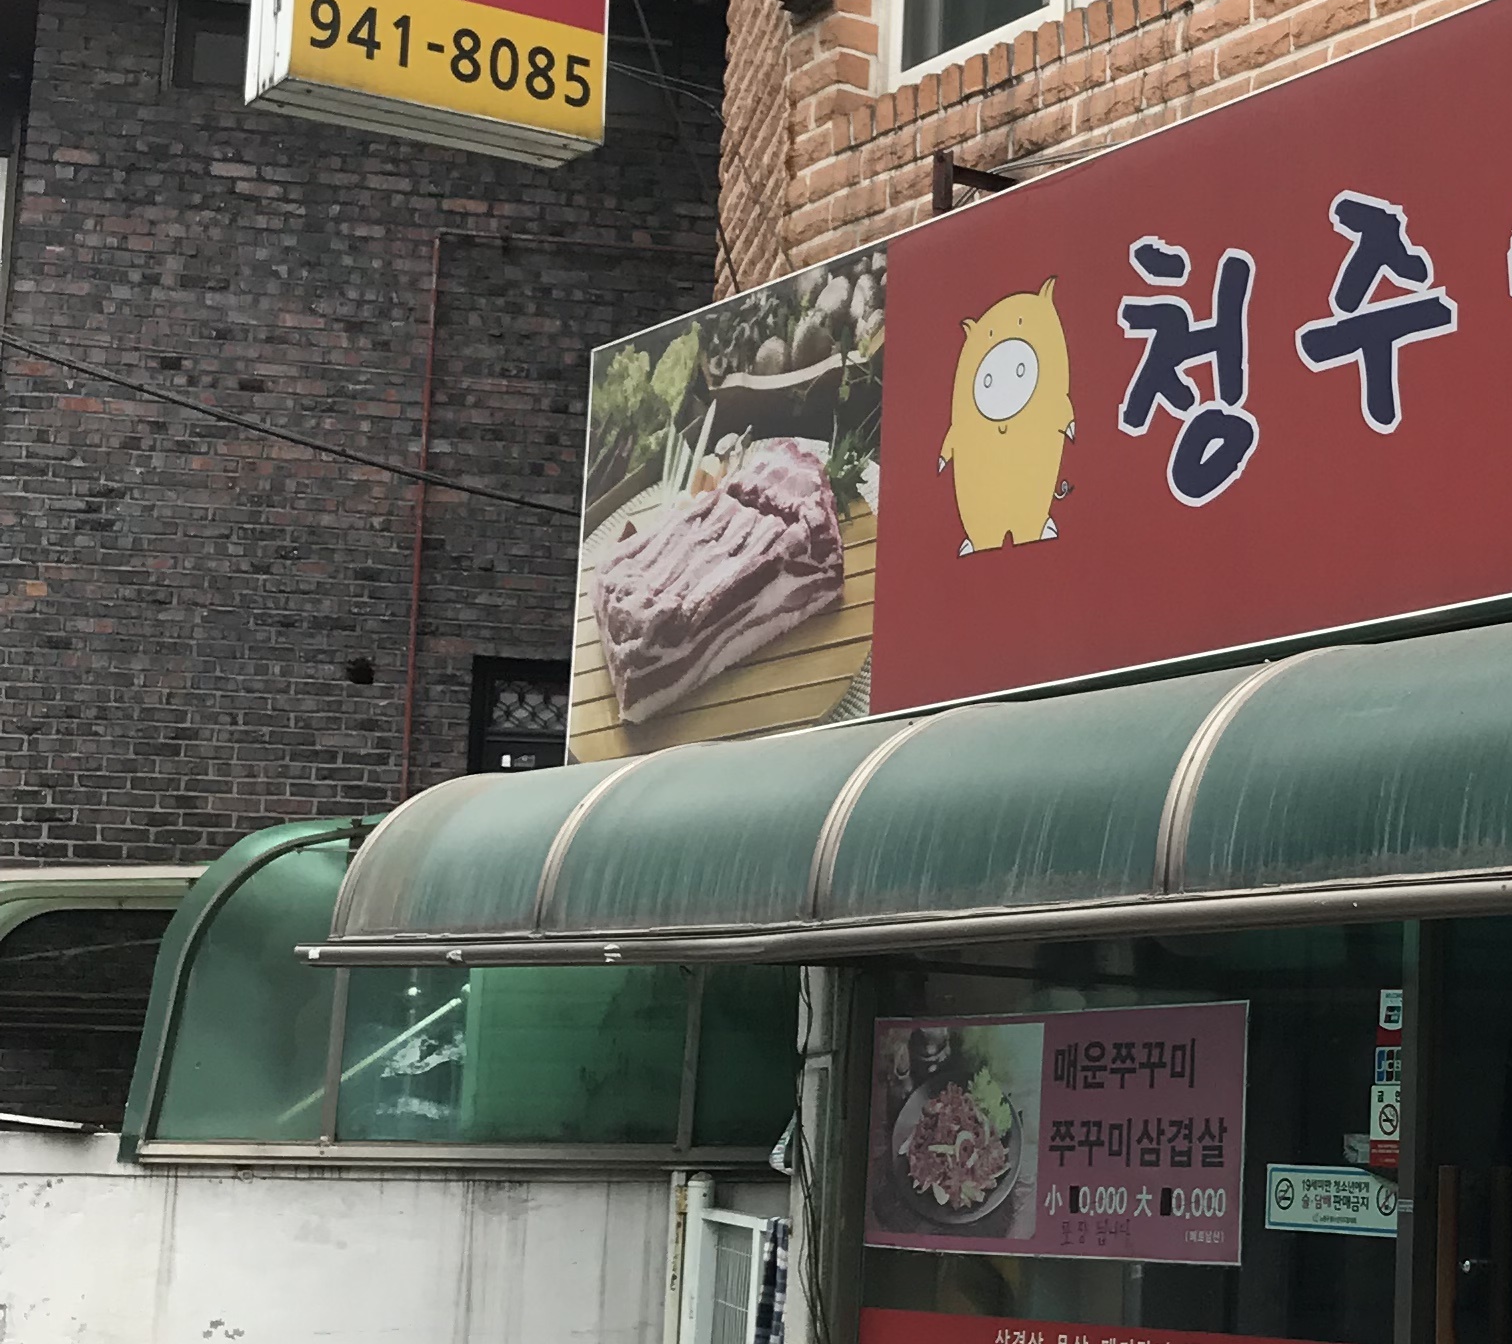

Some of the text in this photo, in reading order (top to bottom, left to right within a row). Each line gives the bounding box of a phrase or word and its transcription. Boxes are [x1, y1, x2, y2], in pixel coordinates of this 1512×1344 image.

[1053, 1037, 1197, 1091] 매운쭈꾸미
[1048, 1116, 1228, 1169] 쭈꾸미삼겹살
[1069, 1185, 1128, 1217] 0.000
[1133, 1185, 1152, 1217] 大
[1160, 1187, 1226, 1220] 0.000
